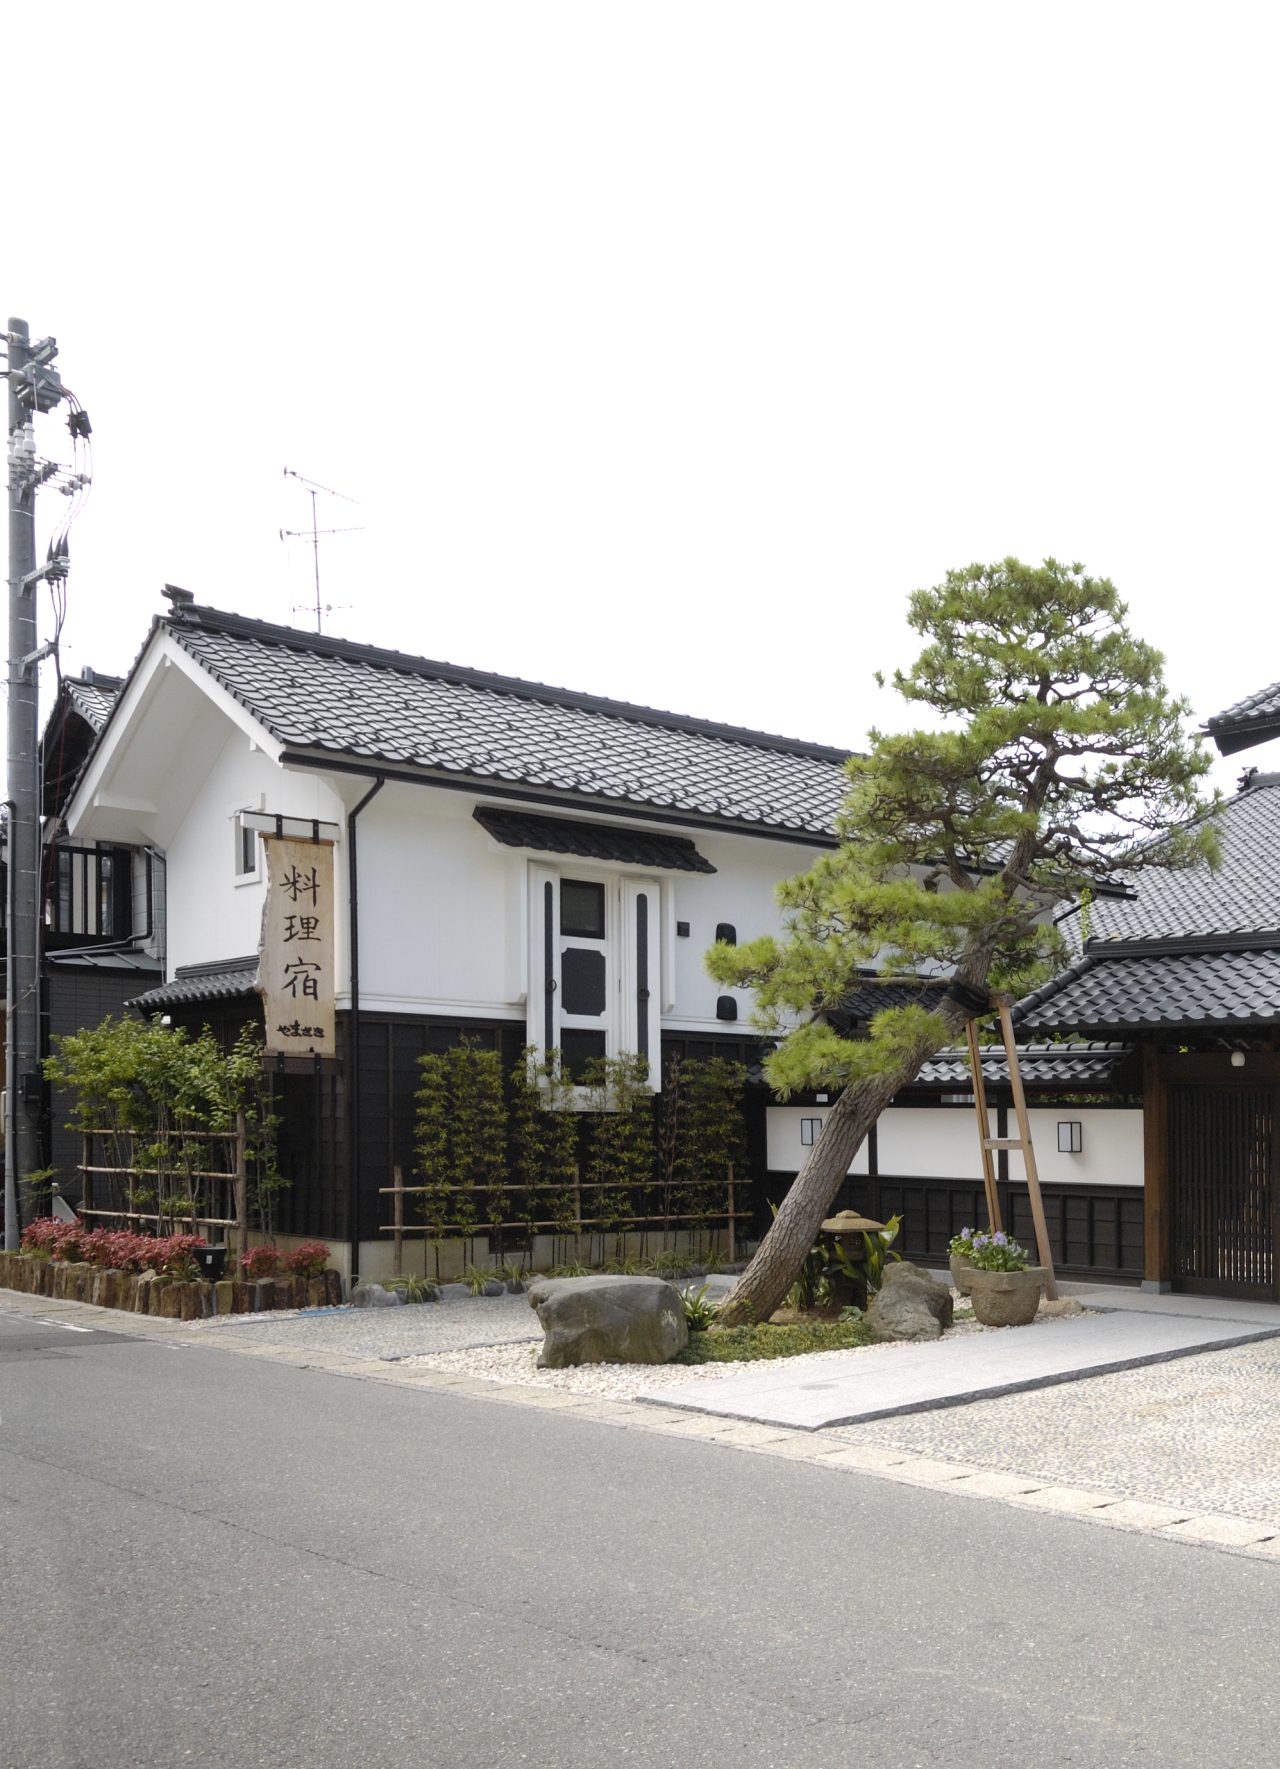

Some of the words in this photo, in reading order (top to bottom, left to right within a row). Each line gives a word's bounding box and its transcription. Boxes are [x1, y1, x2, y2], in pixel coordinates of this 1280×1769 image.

[279, 865, 322, 1000] 料理宿
[277, 1019, 325, 1038] やまざき
